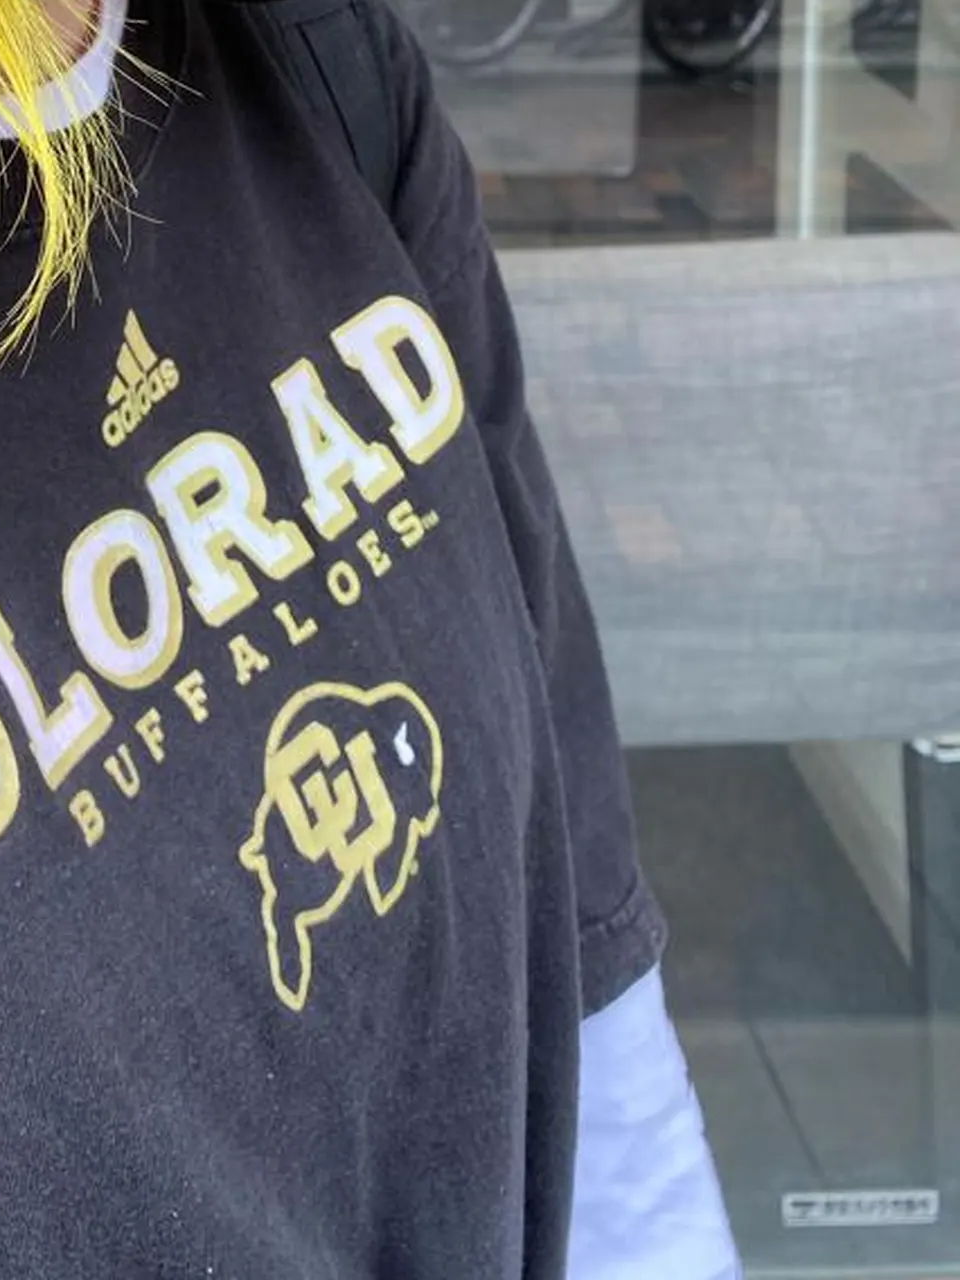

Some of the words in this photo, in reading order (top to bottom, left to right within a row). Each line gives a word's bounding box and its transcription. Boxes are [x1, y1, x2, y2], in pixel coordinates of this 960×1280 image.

[101, 358, 180, 448] adidas
[69, 499, 424, 846] BUFFALOES
[266, 721, 395, 872] CU
